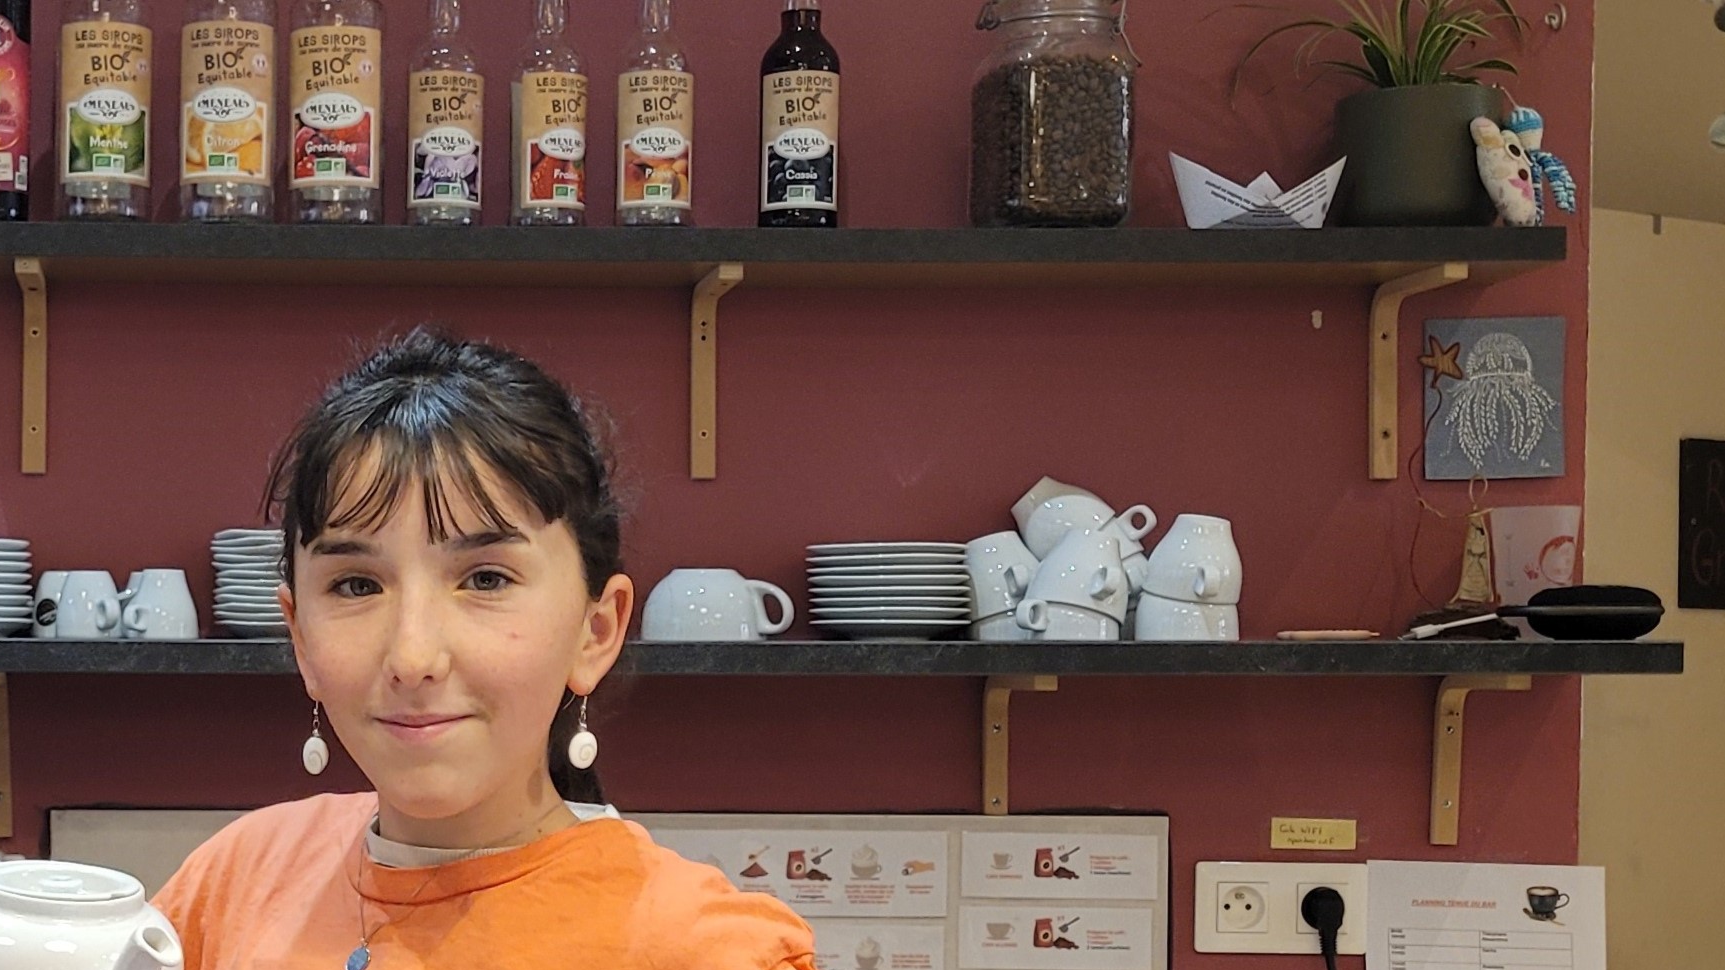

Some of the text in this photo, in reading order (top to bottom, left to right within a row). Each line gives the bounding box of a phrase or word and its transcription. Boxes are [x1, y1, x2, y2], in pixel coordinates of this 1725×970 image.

[75, 30, 144, 45] LES SIROPS
[191, 28, 260, 42] LES SIROPS
[298, 34, 367, 48] LES SIROPS
[91, 54, 125, 71] BIO
[204, 51, 238, 70] BIO
[312, 57, 345, 76] BIO
[84, 72, 138, 86] Equitable
[197, 68, 253, 85] Equitable
[305, 75, 360, 91] Equitable
[419, 76, 437, 86] LES
[536, 77, 556, 87] LES
[629, 76, 688, 88] LES SIROPS
[773, 76, 833, 88] LES SIROPS
[432, 96, 461, 111] BIO
[552, 98, 578, 113] BIO
[643, 96, 672, 112] BIO
[785, 96, 815, 113] BIO
[636, 111, 683, 125] Equitable
[779, 111, 827, 126] Equitable
[89, 135, 128, 149] Menthe
[304, 140, 357, 154] Grenadine
[785, 166, 818, 180] Cassis
